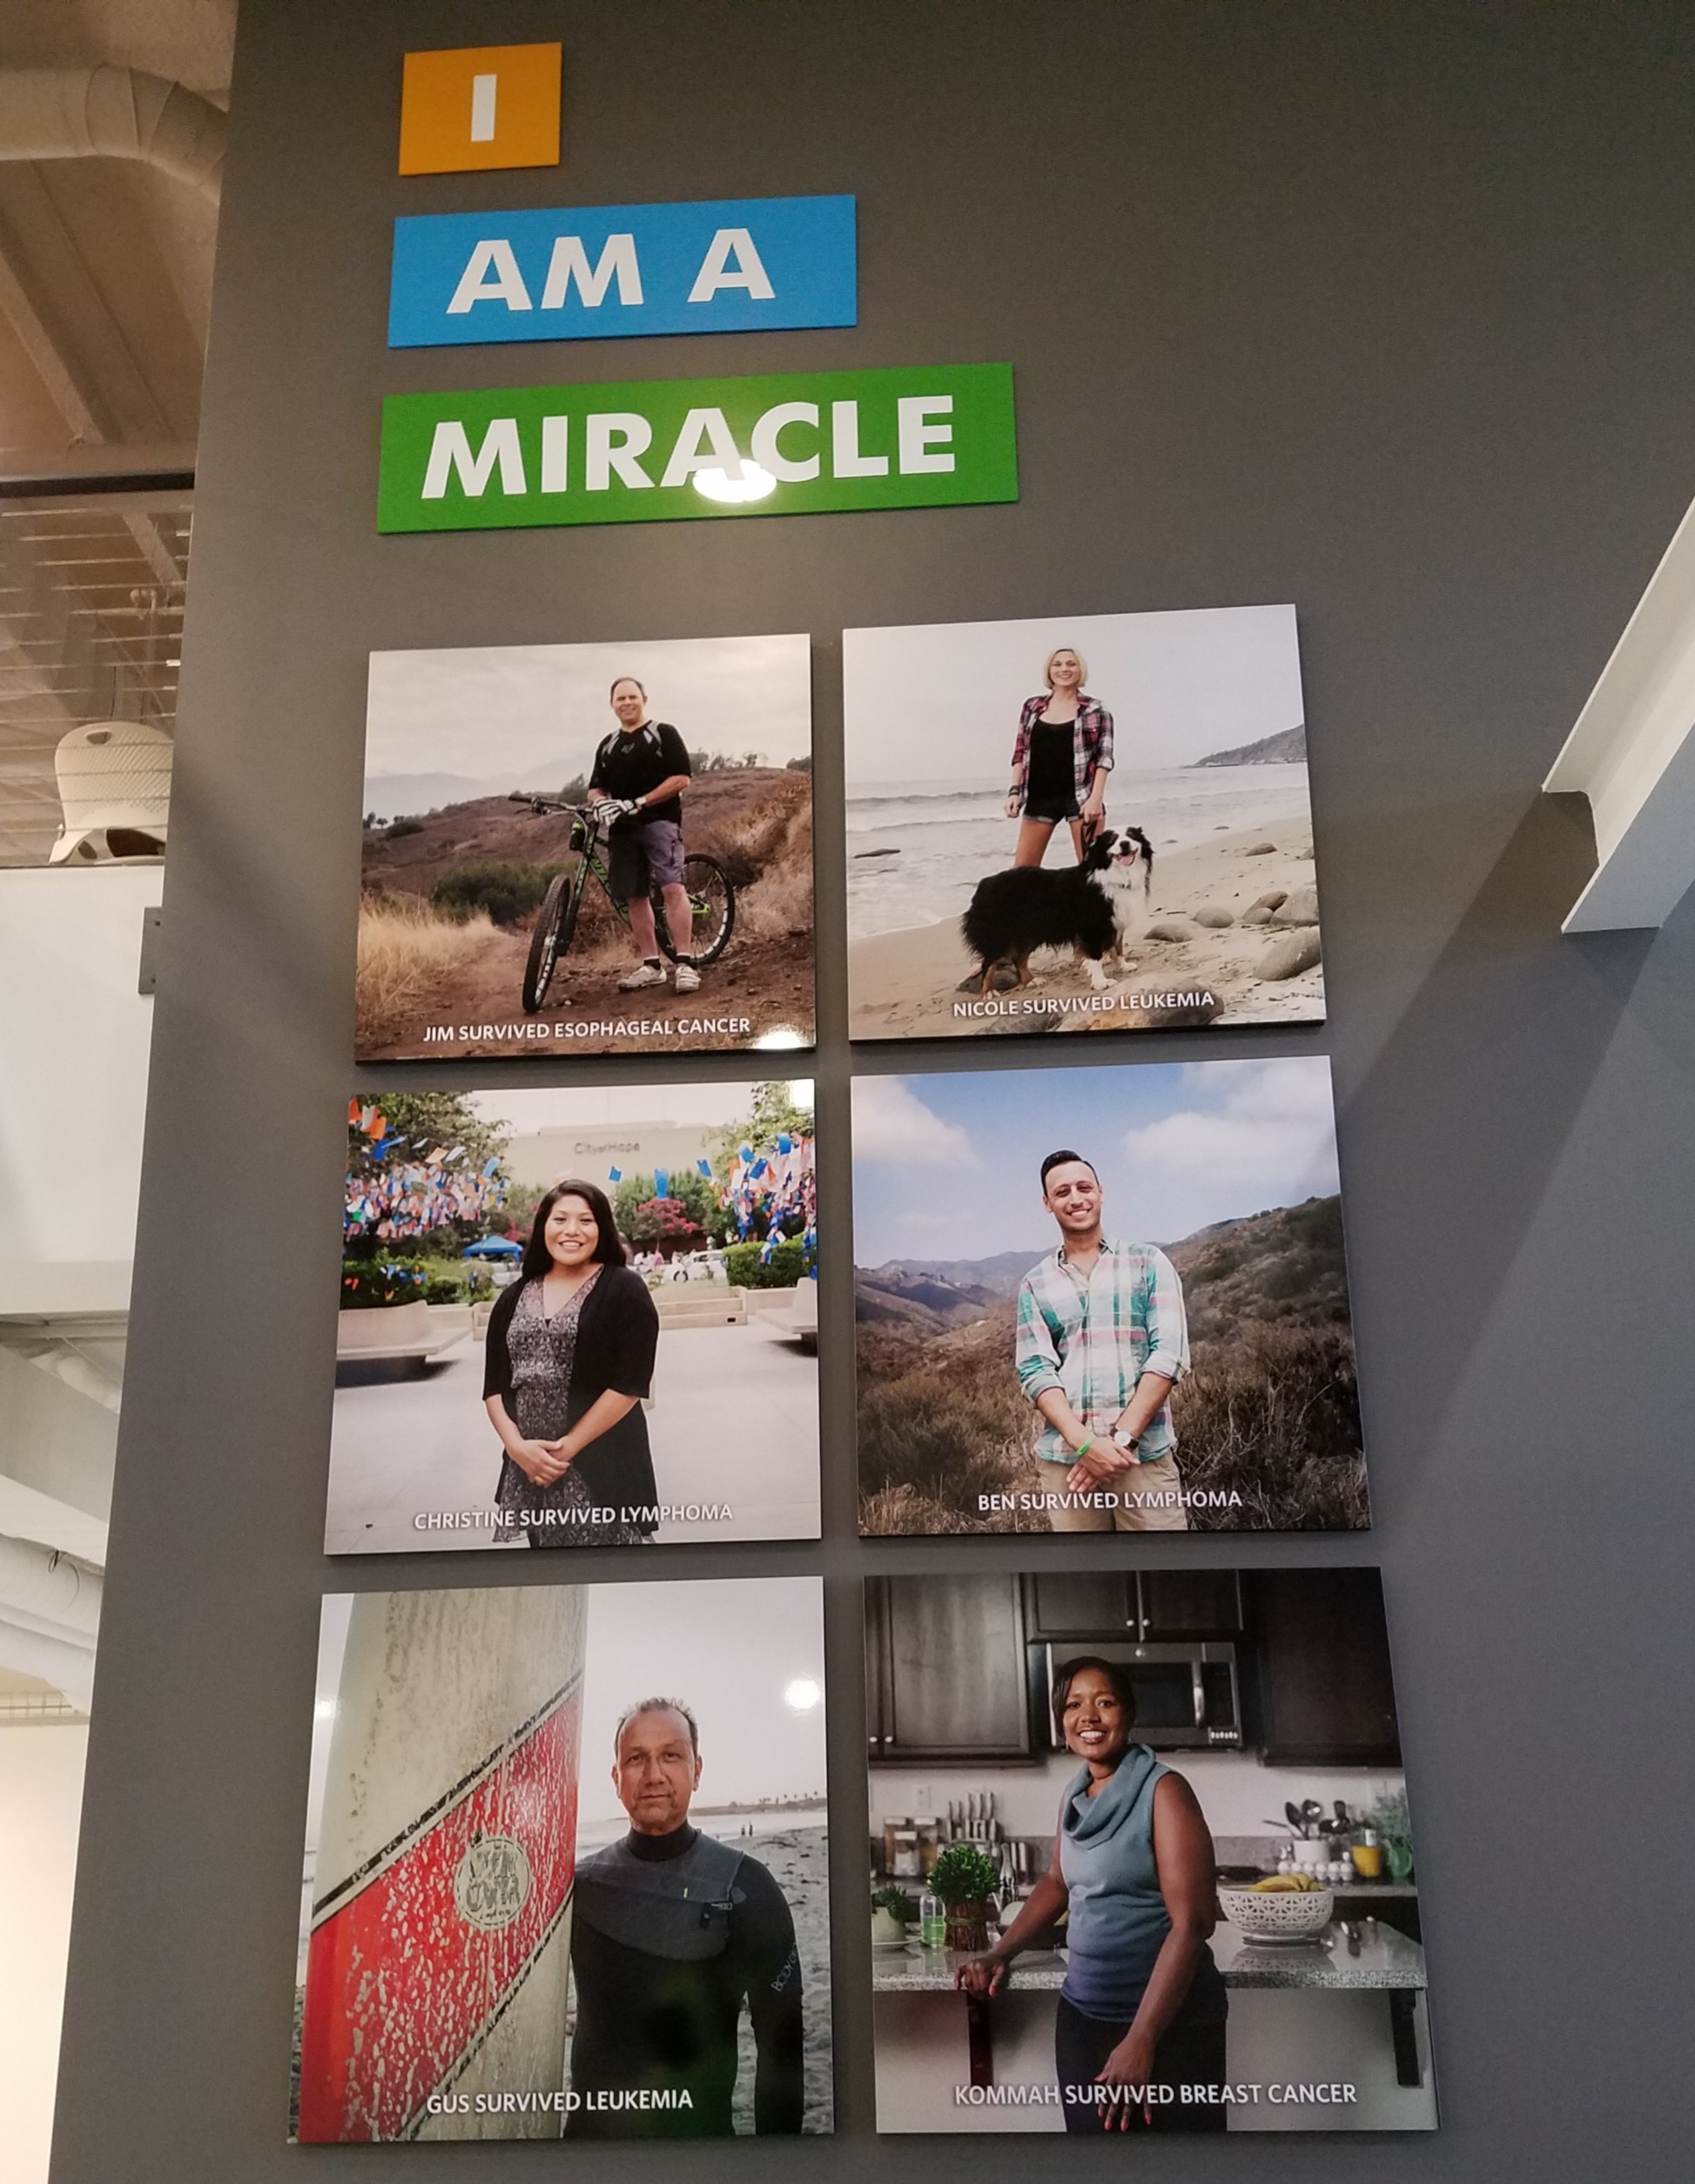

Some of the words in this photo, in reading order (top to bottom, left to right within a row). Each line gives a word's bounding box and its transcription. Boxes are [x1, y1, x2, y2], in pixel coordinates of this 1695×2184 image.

[471, 74, 497, 142] I
[446, 233, 644, 314] AM
[687, 228, 776, 301] A
[421, 394, 955, 499] MIRACLE
[953, 1001, 1019, 1017] NICOLE
[1023, 997, 1115, 1014] SURVIVED
[1120, 991, 1215, 1010] LEUKEMIA
[423, 1026, 454, 1042] JIM
[459, 1021, 550, 1040] SURVIVED
[555, 1019, 674, 1037] ESOPHAGEAL
[677, 1017, 750, 1034] CANCER
[978, 1494, 1016, 1511] BEN
[1020, 1493, 1120, 1510] SURVIVED
[1124, 1490, 1243, 1508] LYMPHOMA
[414, 1511, 515, 1530] CHRISTINE
[520, 1507, 616, 1527] SURVIVED
[621, 1504, 733, 1523] LYMPHOMA
[427, 2094, 470, 2113] GUS
[475, 2092, 581, 2113] SURVIVED
[586, 2089, 695, 2111] LEUKEMIA
[954, 2085, 1059, 2105] KOMMAH
[1065, 2084, 1174, 2105] SURVIVED
[1180, 2084, 1262, 2104] BREAST
[1268, 2083, 1358, 2104] CANCER
